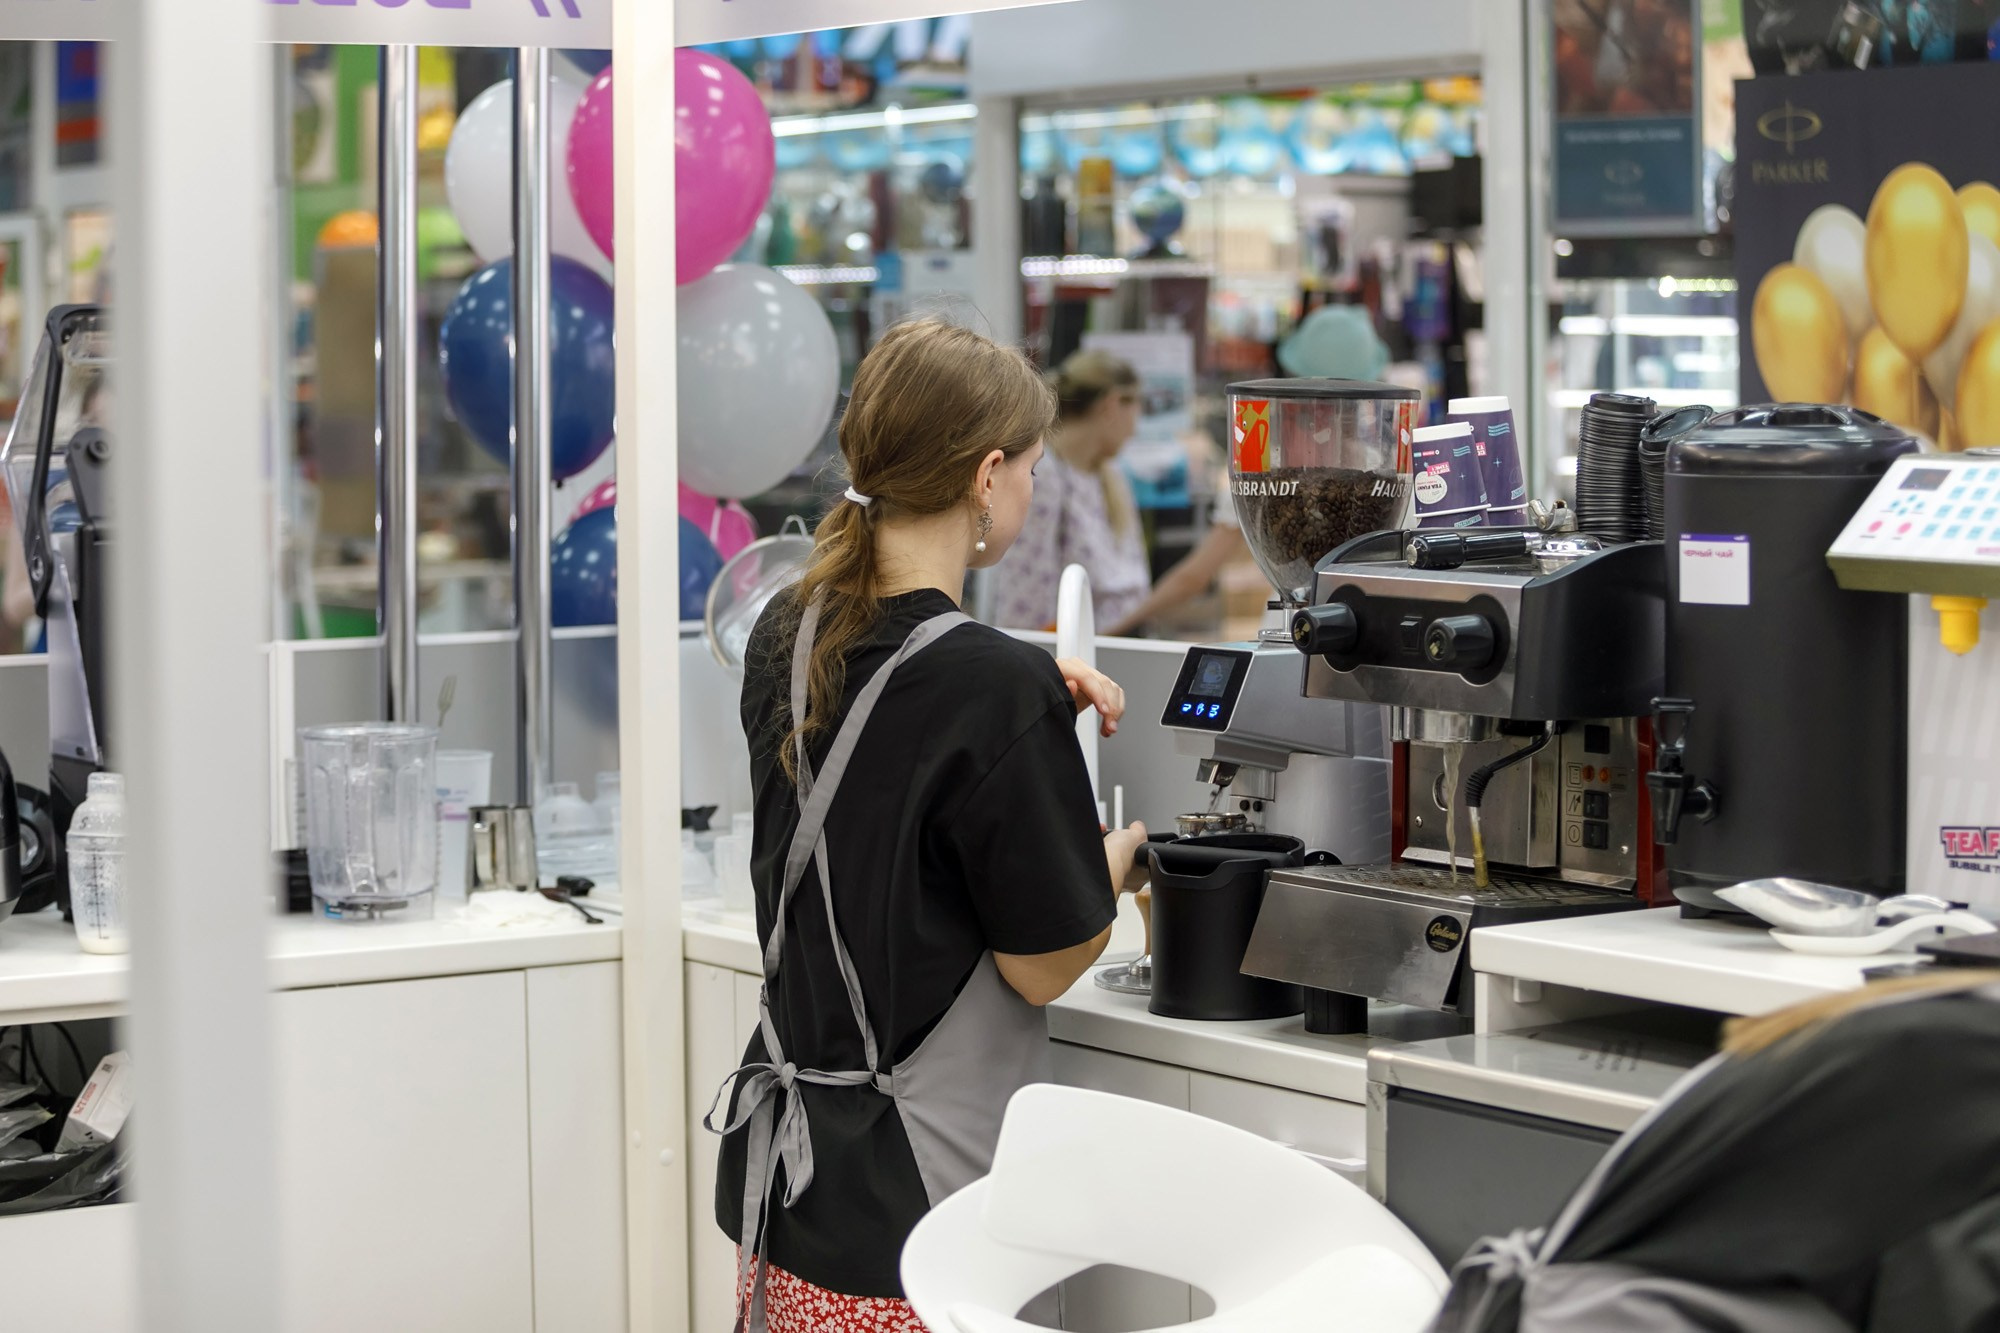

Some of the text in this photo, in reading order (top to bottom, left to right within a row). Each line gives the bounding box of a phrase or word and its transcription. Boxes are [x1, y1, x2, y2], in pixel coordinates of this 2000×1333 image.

[1231, 481, 1300, 496] AUSBRANDT
[1943, 829, 1984, 855] TEA
[1949, 860, 1991, 873] BUBBLE
